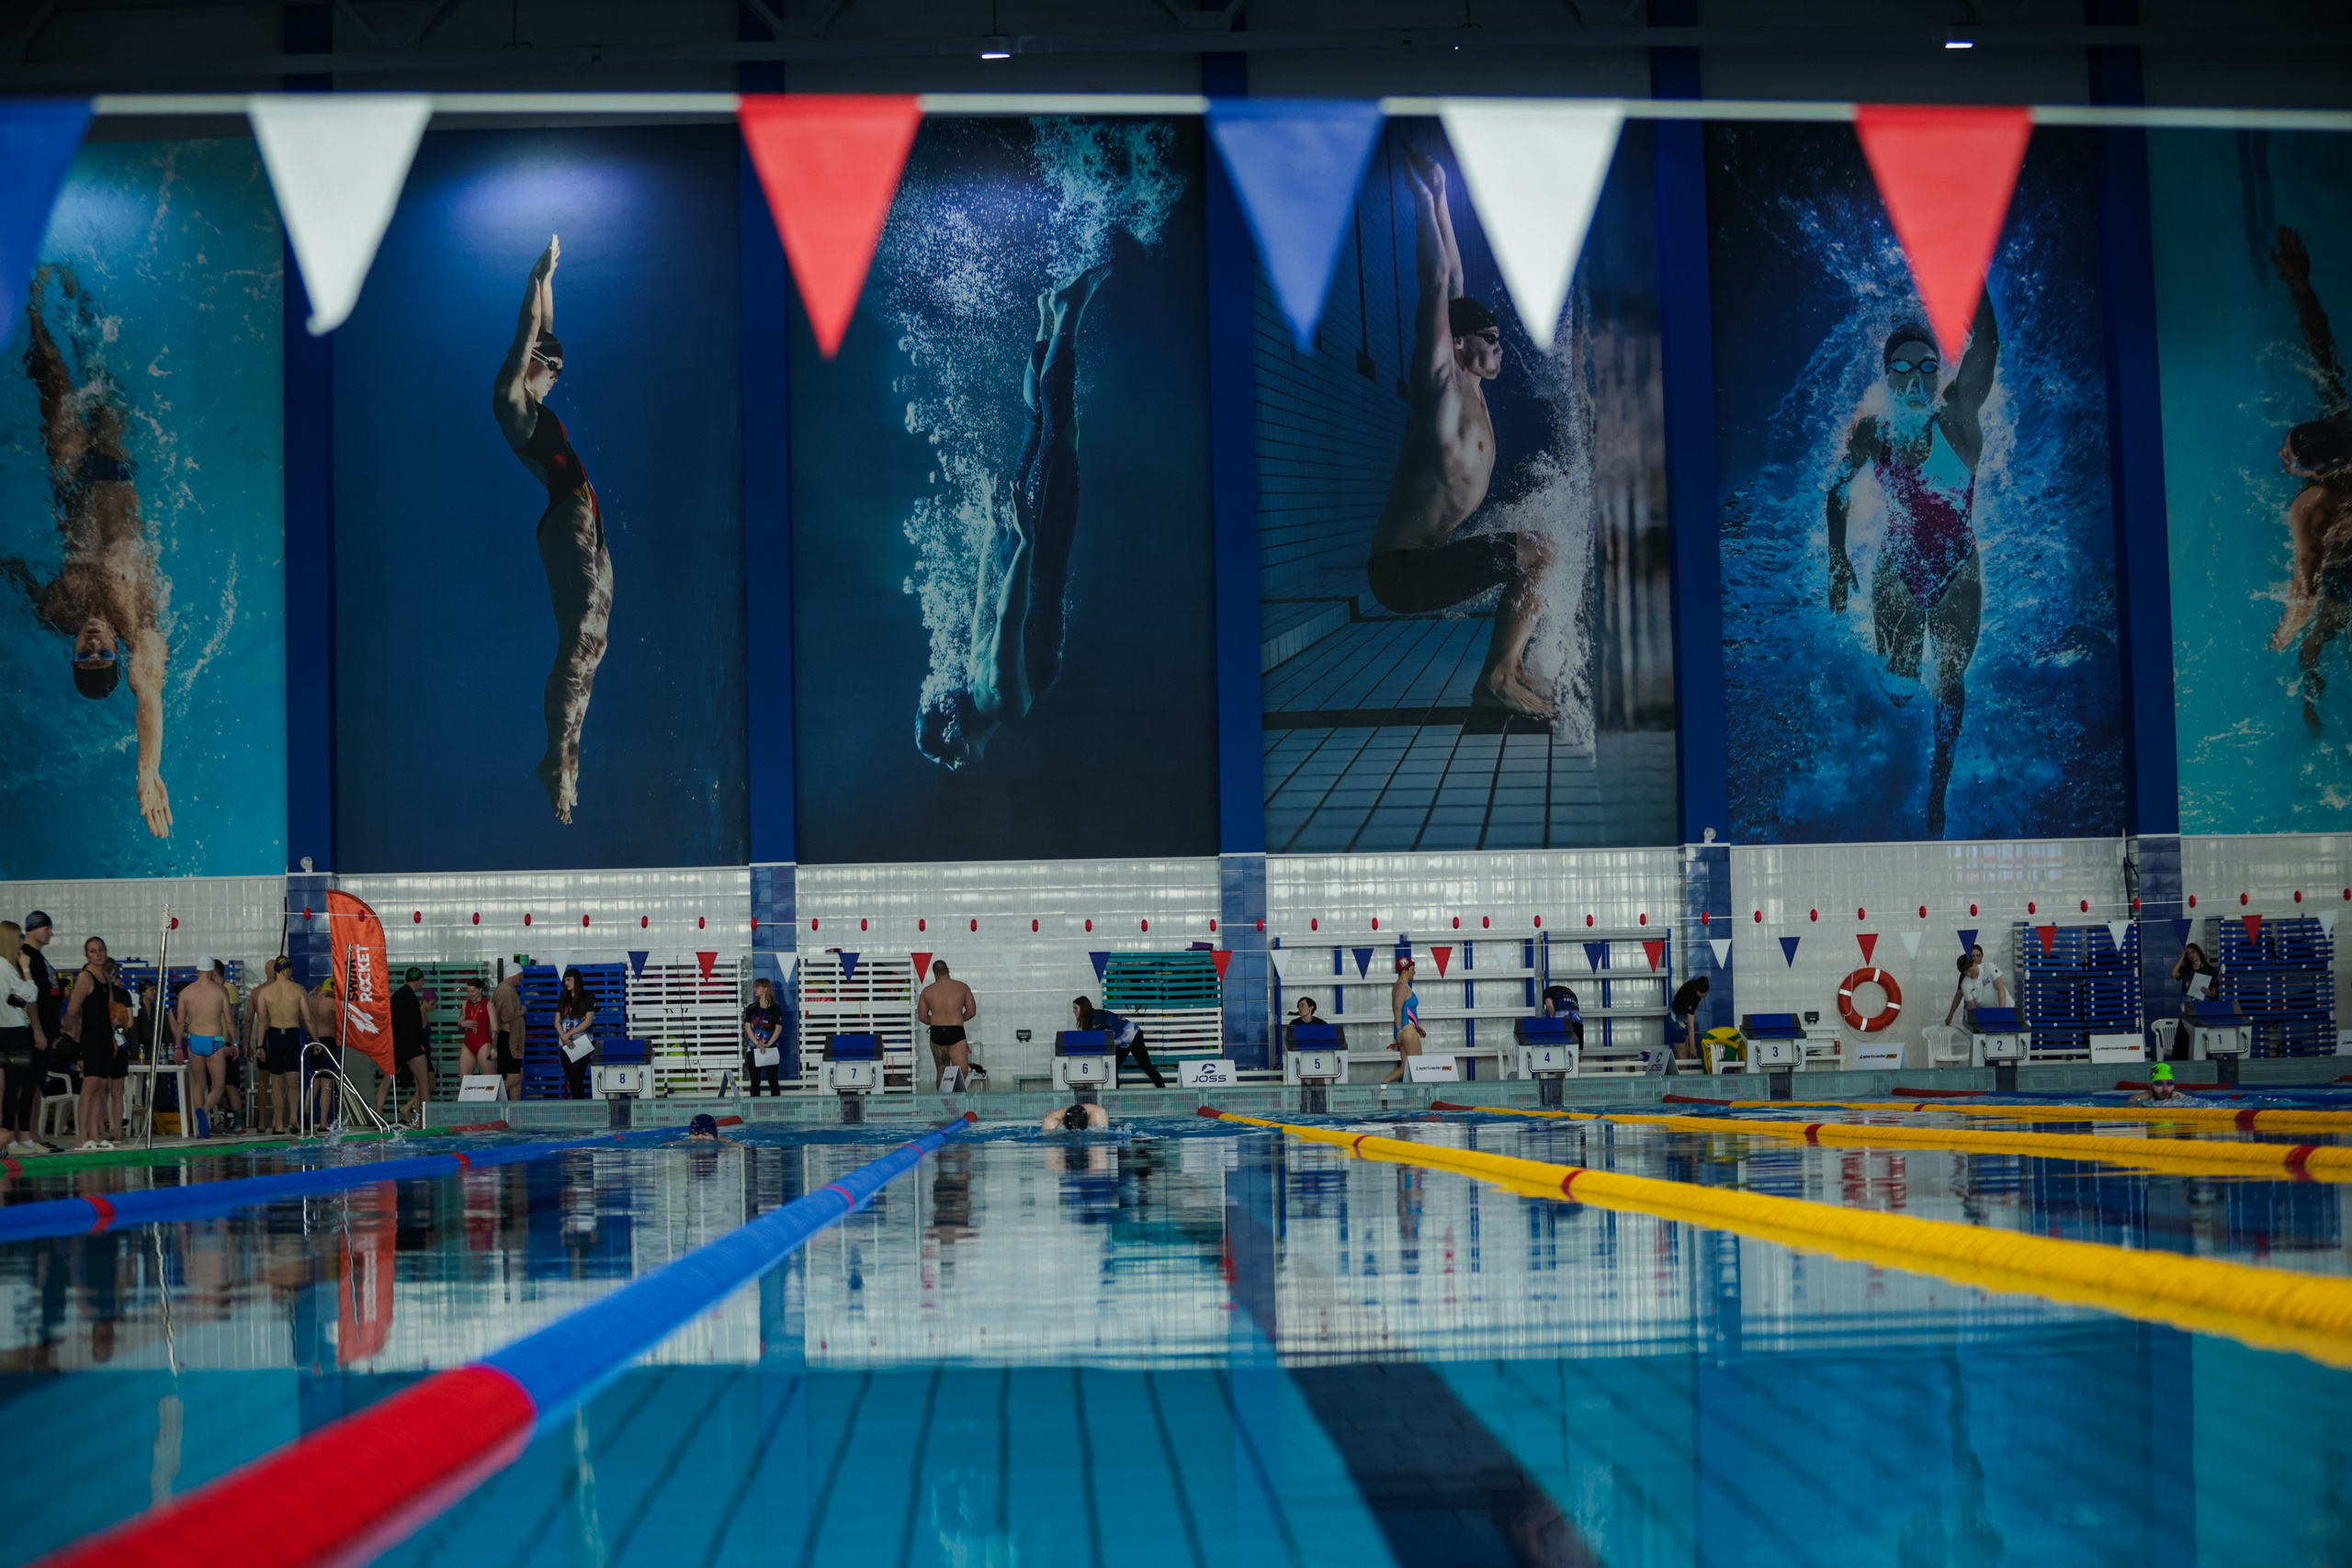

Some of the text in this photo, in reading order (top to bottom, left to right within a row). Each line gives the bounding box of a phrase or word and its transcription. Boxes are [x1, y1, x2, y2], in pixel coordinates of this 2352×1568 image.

[356, 943, 374, 1002] ROCKET
[345, 959, 359, 1002] SWIM
[2217, 1033, 2222, 1044] 1
[1996, 1040, 2003, 1051] 2
[1772, 1046, 1779, 1057] 3
[1544, 1052, 1551, 1063] 4
[1082, 1063, 1089, 1074] 6
[1315, 1058, 1320, 1069] 5
[619, 1073, 626, 1084] 8
[851, 1068, 857, 1079] 7
[1192, 1075, 1227, 1083] JOSS
